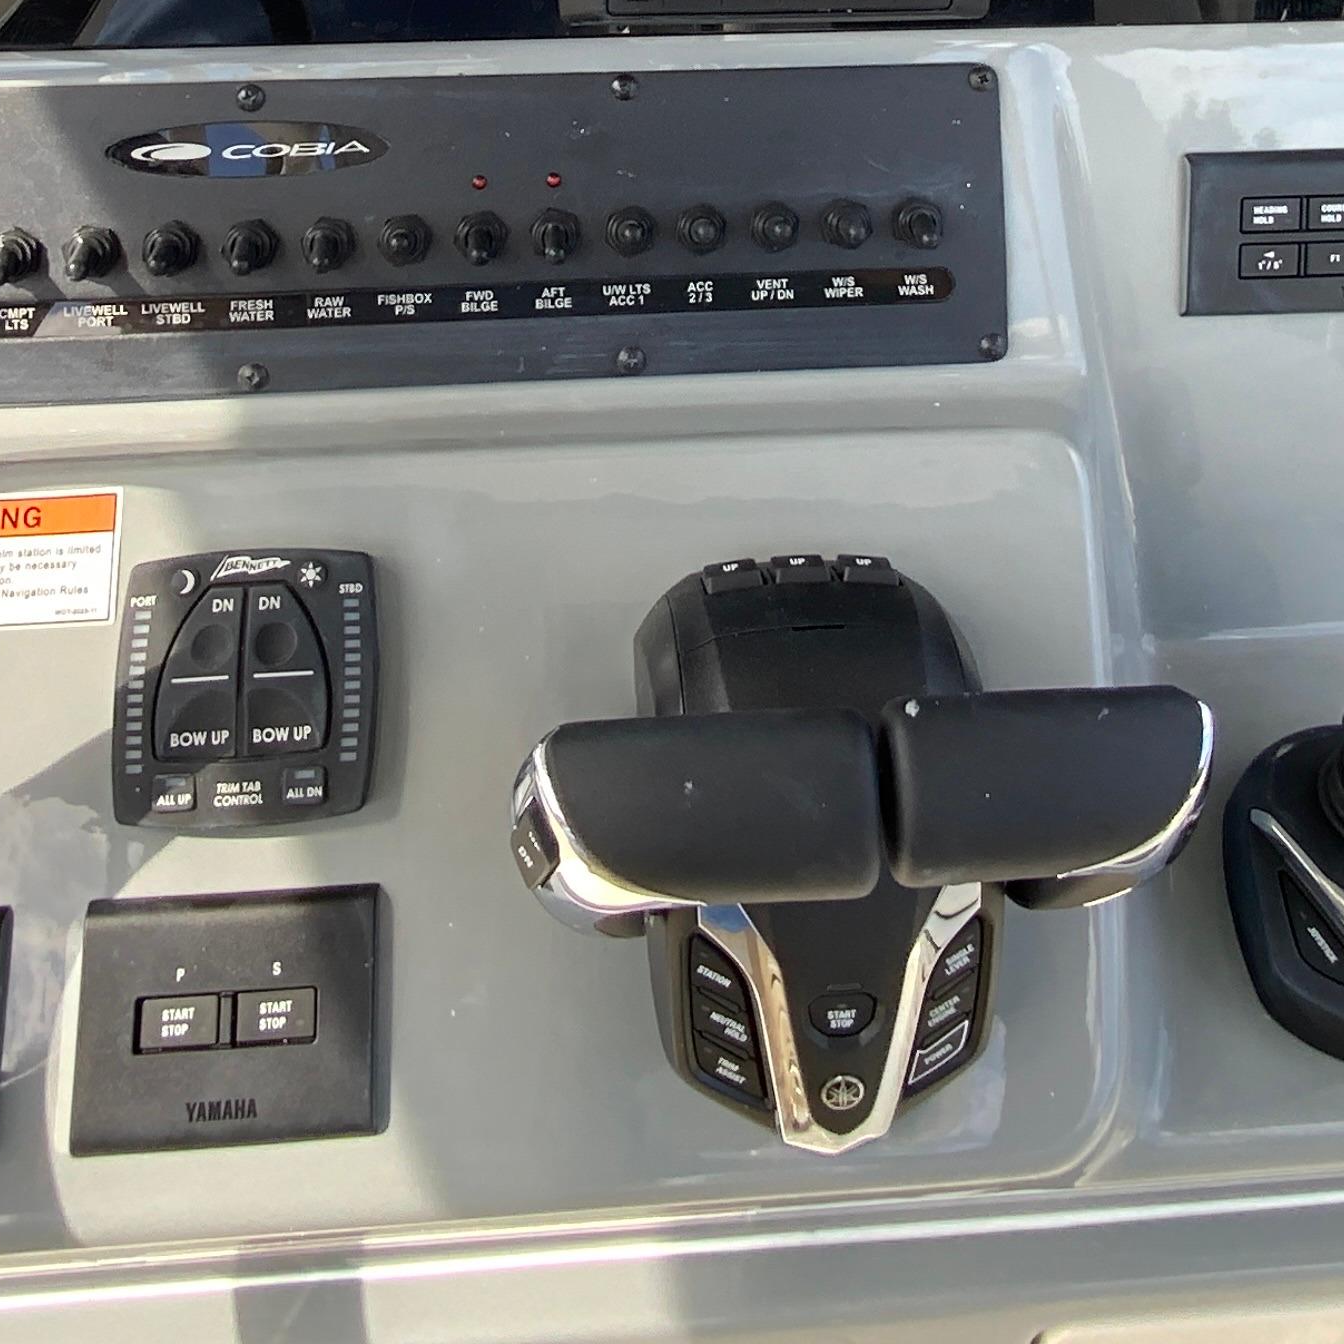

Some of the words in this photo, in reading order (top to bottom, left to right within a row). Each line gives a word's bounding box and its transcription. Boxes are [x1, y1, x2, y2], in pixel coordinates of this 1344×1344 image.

[222, 140, 370, 159] COBIA
[756, 279, 788, 290] VENT
[831, 276, 855, 288] W/S
[904, 274, 927, 285] W/S
[541, 287, 566, 298] AFT
[602, 284, 626, 296] U/W
[629, 283, 651, 295] LTS
[687, 281, 713, 292] ACC
[824, 287, 863, 298] WIPER
[898, 284, 934, 296] WASH
[314, 296, 345, 307] RAW
[377, 293, 432, 305] FISHBOX
[465, 290, 494, 302] FWD
[609, 295, 635, 306] ACC
[638, 294, 644, 305] 1
[141, 302, 205, 314] LIVEWELL
[230, 299, 273, 311] FRESH
[461, 301, 498, 313] BILGE
[534, 297, 572, 309] BILGE
[63, 304, 128, 317] LIVEWELL
[307, 307, 351, 319] WATER
[394, 304, 415, 316] P/S
[77, 316, 114, 327] PORT
[156, 313, 191, 325] STBD
[229, 310, 275, 323] WATER
[5, 319, 29, 331] LTS
[18, 548, 52, 557] station
[67, 544, 102, 554] limited
[9, 562, 21, 571] be
[25, 560, 77, 571] necessary
[722, 563, 739, 572] UP
[789, 557, 805, 566] UP
[856, 557, 872, 566] UP
[2, 587, 56, 600] Navigation
[60, 584, 89, 596] Rules
[338, 583, 363, 594] STBD
[130, 595, 158, 607] PORT
[212, 598, 234, 612] DN
[258, 596, 281, 610] DN
[170, 731, 207, 748] BOW
[211, 729, 230, 745] UP
[252, 727, 289, 744] BOW
[293, 725, 312, 741] UP
[216, 782, 241, 795] TRIM
[242, 781, 261, 792] TAB
[286, 788, 305, 799] ALL
[306, 786, 323, 797] DN
[157, 795, 176, 806] ALL
[176, 794, 192, 805] UP
[213, 793, 263, 807] CONTROL
[272, 961, 281, 975] S
[944, 956, 970, 976] LEVER
[176, 968, 185, 982] P
[697, 964, 731, 988] STATION
[259, 1000, 293, 1015] START
[929, 995, 961, 1017] CENTER
[161, 1007, 195, 1022] START
[827, 1009, 856, 1020] START
[259, 1017, 287, 1031] STOP
[710, 1011, 745, 1033] NEUTRAL
[830, 1019, 854, 1029] STOP
[161, 1023, 189, 1037] STOP
[724, 1027, 748, 1042] HOLD
[184, 1098, 258, 1123] YAMAHA
